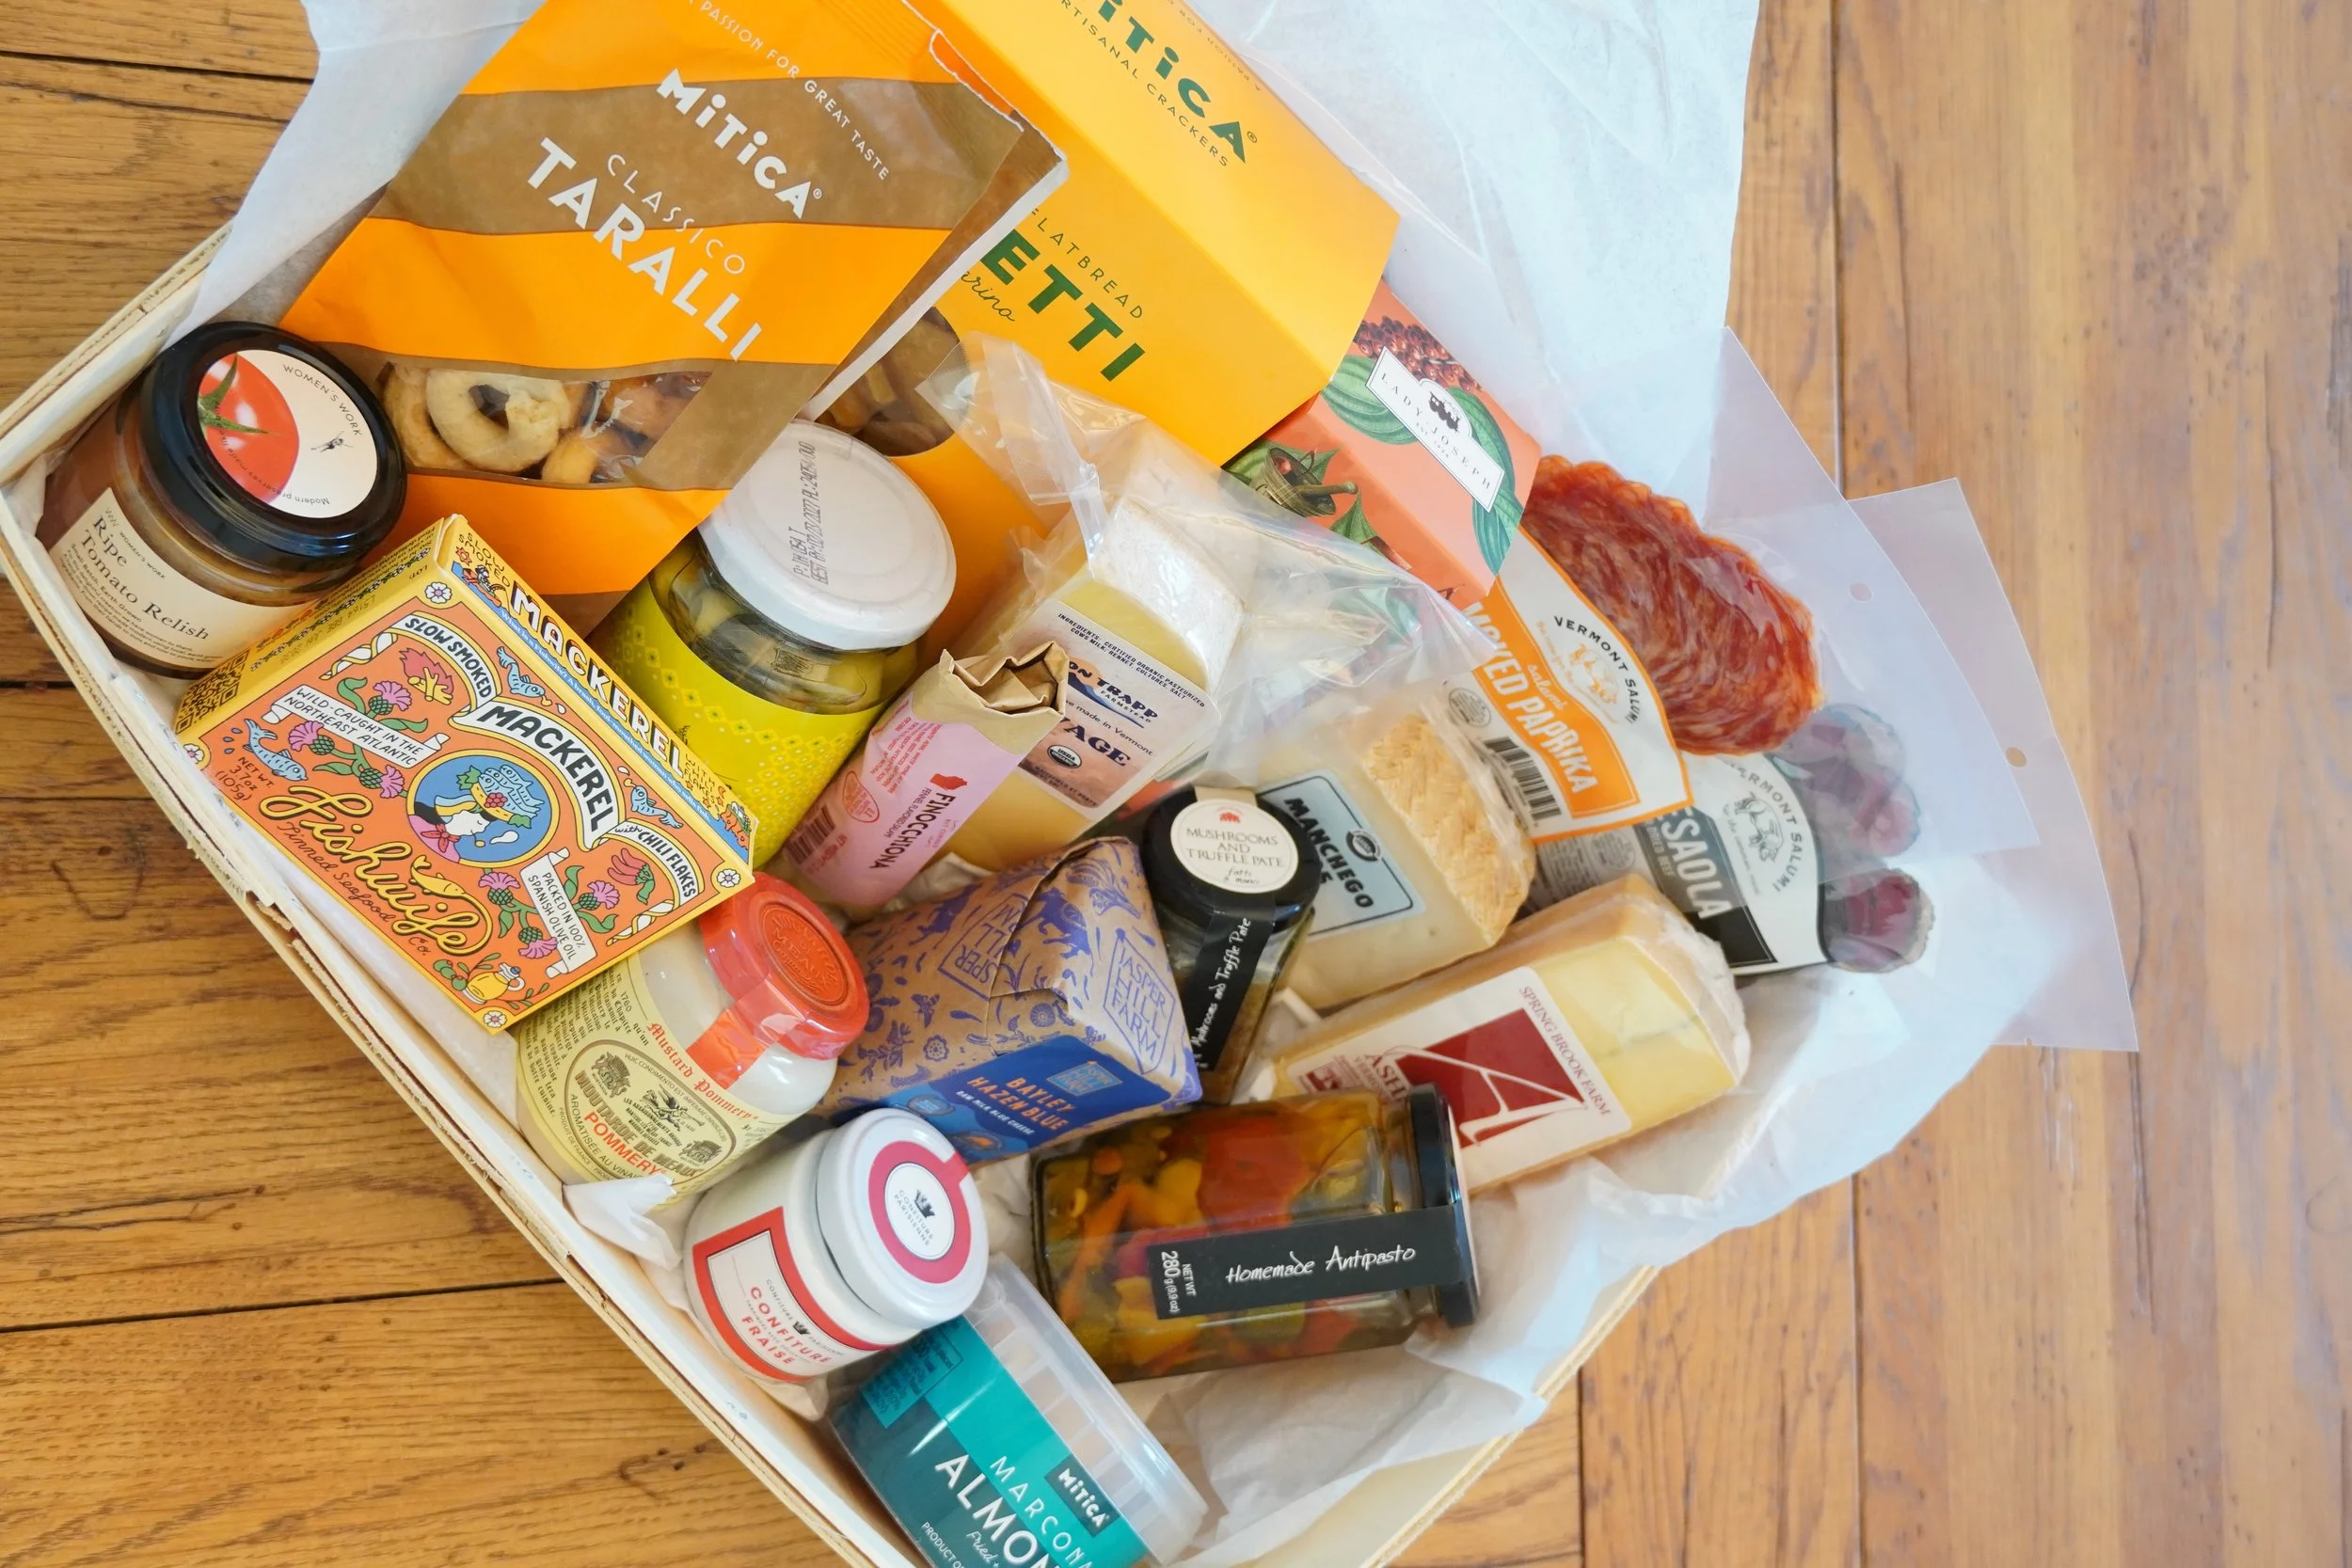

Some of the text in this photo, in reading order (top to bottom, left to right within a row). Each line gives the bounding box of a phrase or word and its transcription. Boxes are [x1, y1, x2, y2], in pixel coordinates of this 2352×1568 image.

[698, 0, 891, 180] PASSION FOR GREAT TASTE
[1061, 0, 1230, 167] RTISANAL CRACKERS
[601, 150, 749, 278] CLASSICO
[516, 136, 764, 362] TARALLI
[979, 229, 1146, 377] ETTI
[283, 363, 361, 437] WOMEN'S WORK
[1380, 372, 1492, 490] LADY JOSEPH
[94, 515, 130, 568] Ripe
[118, 531, 167, 580] WOMEN'S WORK
[455, 532, 512, 588] SMOKED
[465, 531, 506, 573] SLOW
[69, 542, 86, 566] Small
[99, 584, 119, 604] Earth
[118, 601, 143, 624] Grown
[80, 528, 209, 641] Tomato Relish
[404, 616, 493, 697] SLOW SMOKED
[513, 579, 684, 778] MACKEREL
[1069, 626, 1090, 641] COWS
[1168, 687, 1186, 701] SALT
[1103, 640, 1137, 663] CERTIFIED
[1136, 660, 1165, 681] ORGANIC
[1163, 677, 1206, 708] PASTEURIZED
[1525, 661, 1569, 712] salami
[1551, 613, 1629, 673] VERMONT
[1623, 675, 1639, 724] SALUMI
[498, 608, 524, 634] What
[532, 641, 569, 679] Fishwife?
[593, 704, 644, 753] foul-mouthed
[639, 750, 668, 779] woman
[664, 775, 682, 793] who
[678, 790, 698, 808] sells
[1068, 659, 1159, 721] ON TRAPP
[1099, 689, 1152, 724] FARMSTEAD
[1461, 600, 1531, 699] MOKED
[1505, 693, 1599, 793] PAPRIKA
[282, 693, 421, 768] NORTHEAST ATLANTIC
[295, 685, 422, 757] WILD-CAUGHT IN THE
[1057, 715, 1131, 768] AGE
[1074, 704, 1154, 756] made in Vermont
[228, 762, 260, 793] 3.7oz
[236, 753, 260, 777] NET
[475, 699, 615, 834] MACKEREL
[683, 753, 717, 787] WITH
[683, 762, 714, 792] CHILI
[1057, 747, 1076, 762] USDA
[211, 768, 252, 807] (105g)
[682, 768, 716, 803] FLAKES
[895, 801, 918, 826] FLAVORED
[912, 785, 931, 806] FENNEL
[867, 789, 956, 871] FINOCCHIONA
[1185, 828, 1278, 845] MUSHROOMS
[1186, 847, 1284, 866] TRUFFLE PATE
[1216, 840, 1250, 853] AND
[1282, 797, 1375, 911] MANCHEGO
[1645, 825, 1675, 878] DRIED BEEF
[1729, 763, 1804, 893] ERMONT SALUMI
[261, 794, 490, 955] Fishwife
[276, 818, 432, 958] Tinned Seafood Co.
[613, 824, 699, 900] with CHILI FLAKES
[1654, 805, 1734, 920] SAOLA
[525, 872, 577, 962] SPANISH OLIVE OIL
[539, 869, 588, 950] PACKED IN 100%
[1119, 946, 1166, 1017] JASPER
[1209, 982, 1227, 1000] and
[1229, 917, 1251, 943] Pate
[620, 990, 632, 1013] 1760
[1112, 988, 1152, 1062] FARM
[1116, 966, 1159, 1038] HILL
[623, 1052, 687, 1098] HUIC CONDIMENTO EST
[644, 1021, 692, 1079] Mustard
[1366, 1053, 1408, 1098] ASH
[1519, 986, 1612, 1117] SPRING BROOK FARM
[955, 1089, 1035, 1135] RAW MILK BLUE CHEESE
[965, 1074, 1029, 1111] HAZEN
[1020, 1105, 1069, 1131] BLUE
[1005, 1075, 1075, 1114] BAYLEY
[568, 1094, 644, 1181] AROMATISÉE AU VINAI
[572, 1070, 699, 1180] MOUTARDE DE MEAUX
[572, 1142, 593, 1166] FRANCE
[892, 1193, 930, 1246] PARISIENNE
[897, 1188, 935, 1241] CONFITURE
[1183, 1263, 1197, 1297] NET WT
[1226, 1244, 1416, 1283] Homemade Antipasto
[749, 1286, 833, 1365] CONFITURE
[765, 1278, 794, 1321] CONFITURE
[740, 1314, 796, 1366] FRAISE
[921, 1521, 957, 1564] PRODUCT
[966, 1530, 998, 1564] Fried
